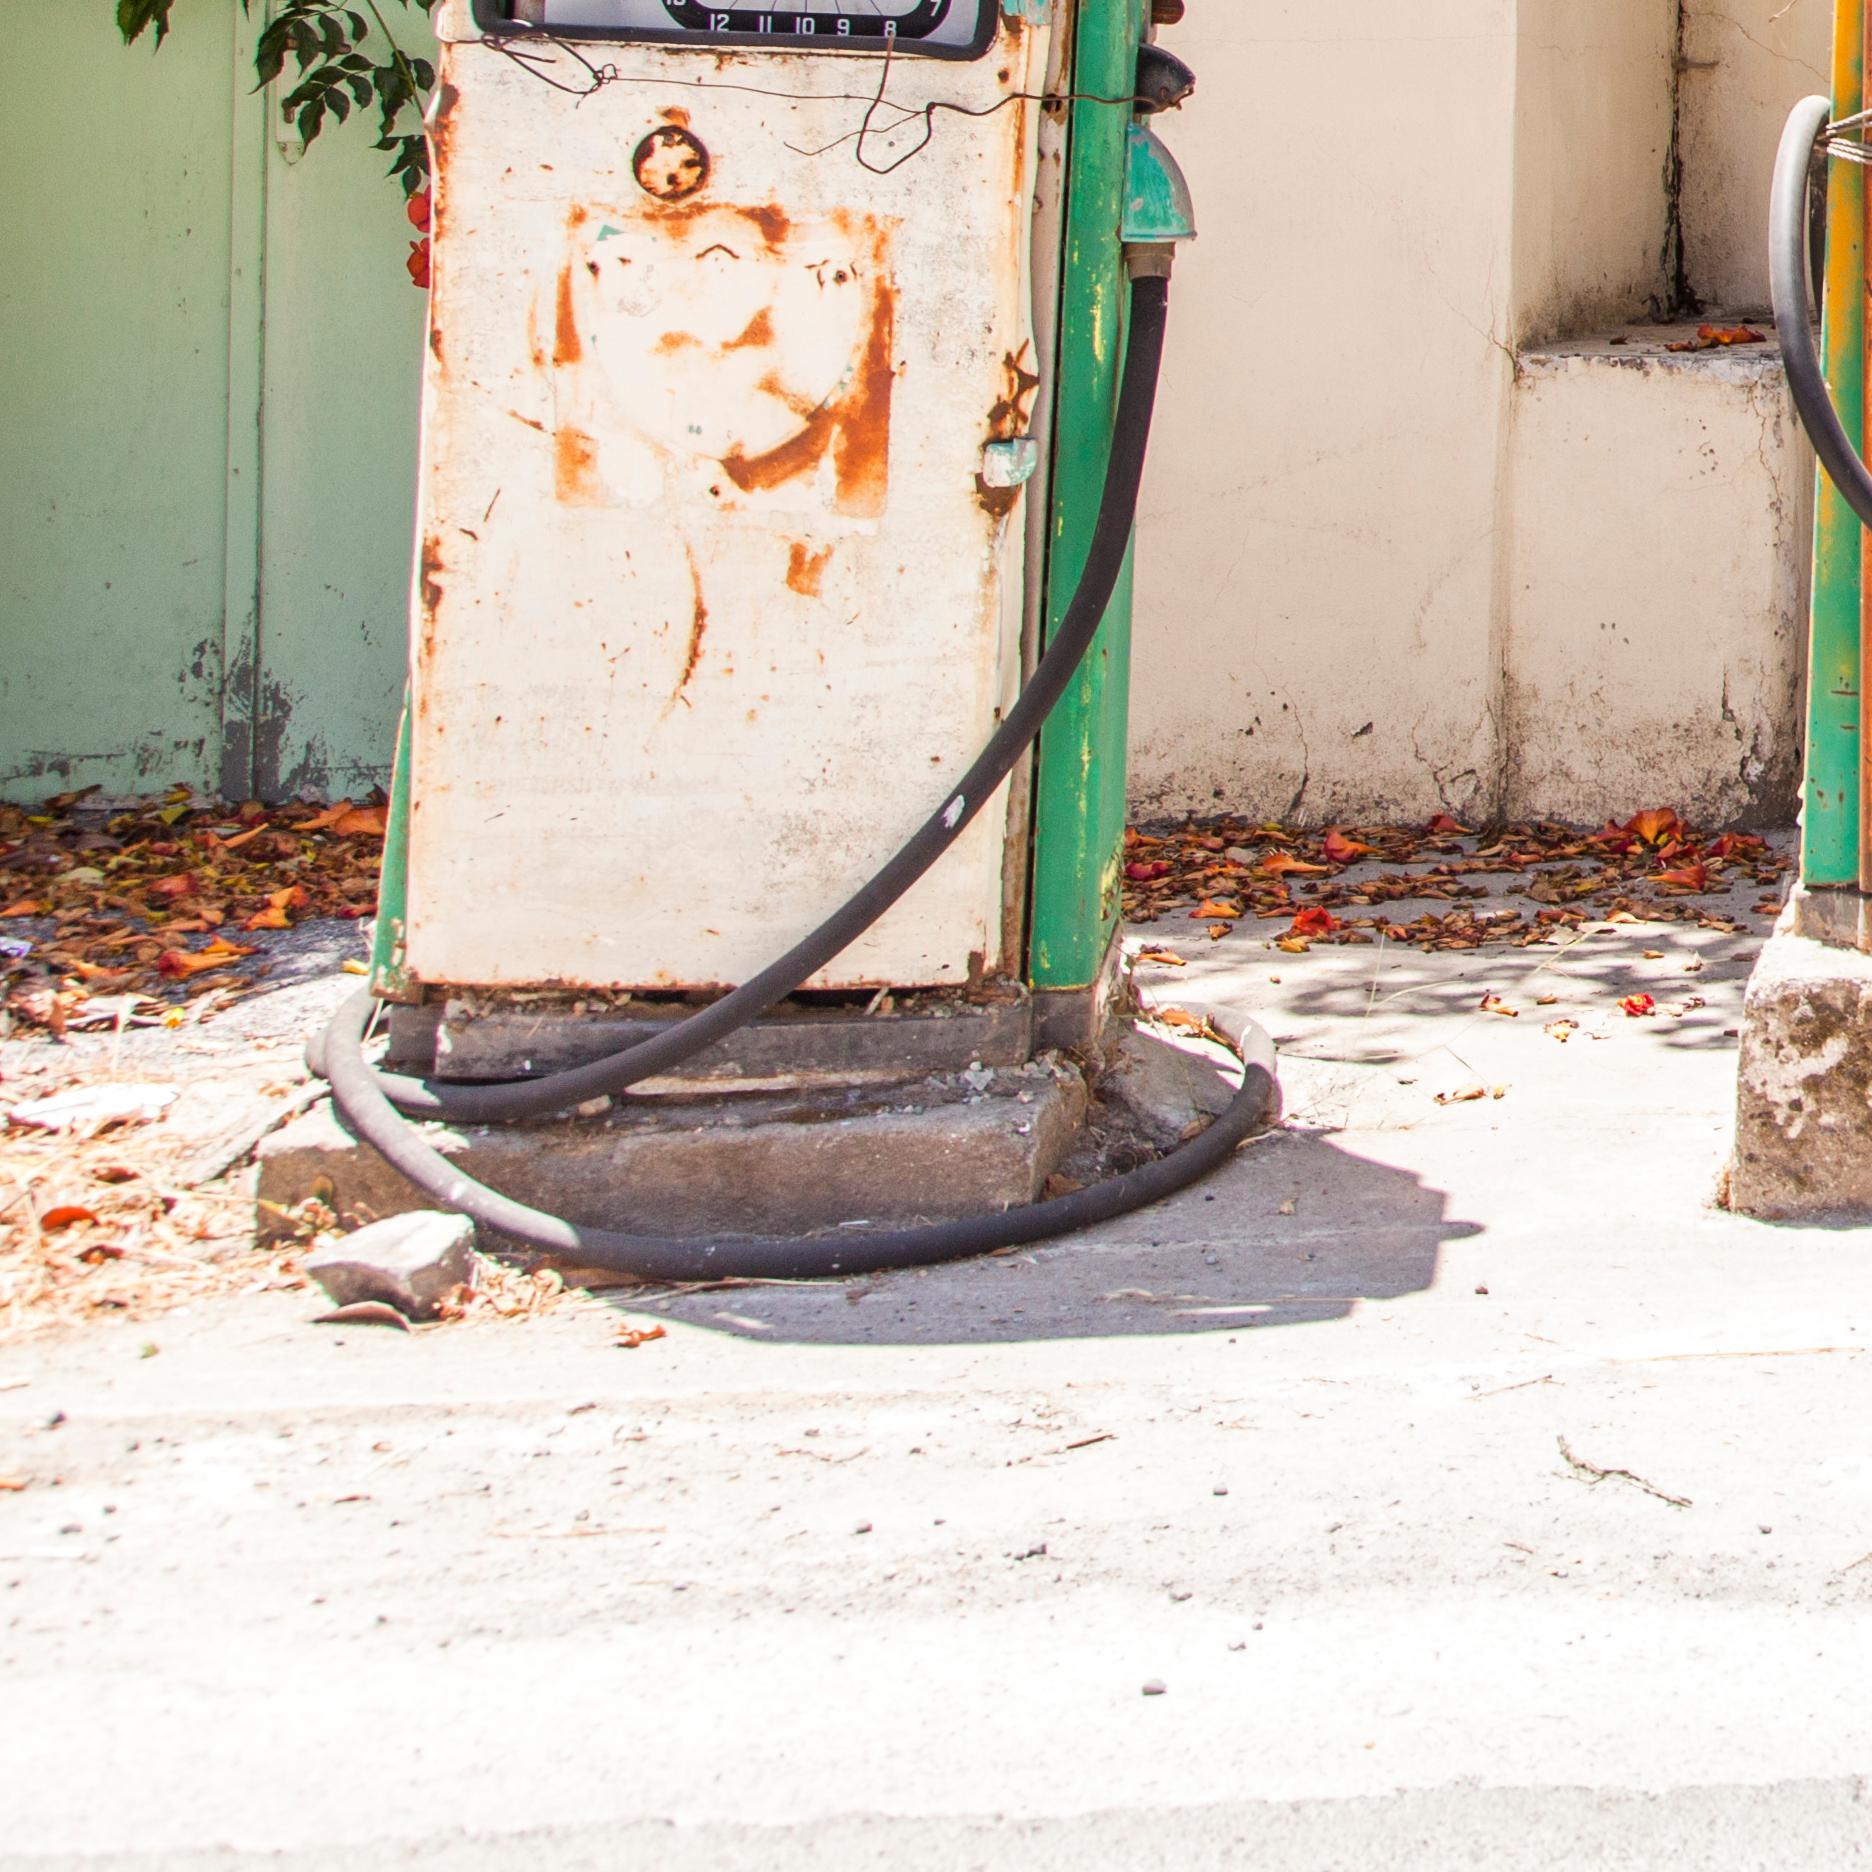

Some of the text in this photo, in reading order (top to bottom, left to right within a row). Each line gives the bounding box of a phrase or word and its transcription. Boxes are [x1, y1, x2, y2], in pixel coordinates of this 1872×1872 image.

[710, 13, 897, 39] 12 11 10 9 8
